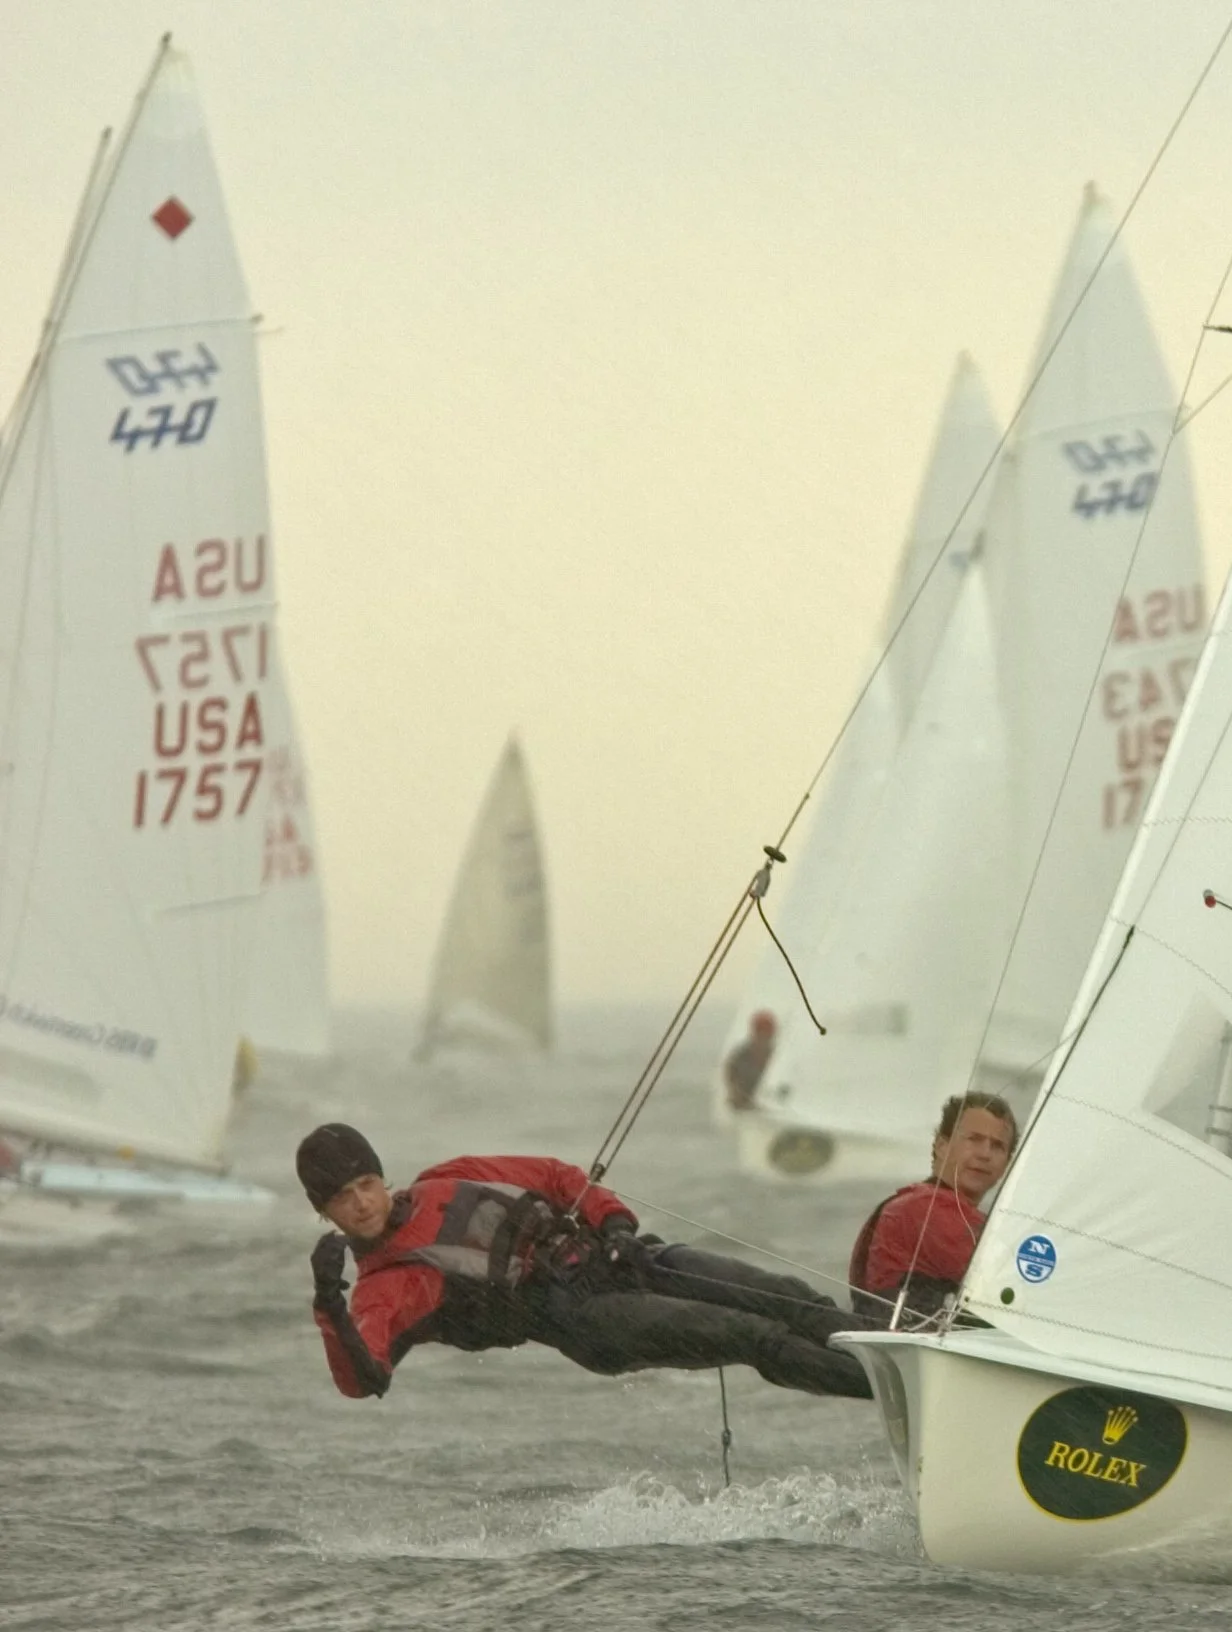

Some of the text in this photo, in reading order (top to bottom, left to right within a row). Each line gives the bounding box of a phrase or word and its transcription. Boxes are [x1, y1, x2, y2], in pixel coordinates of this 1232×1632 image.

[109, 397, 219, 453] 470
[1070, 471, 1160, 519] 470
[154, 692, 264, 758] USA
[1117, 716, 1177, 774] US
[133, 759, 263, 829] 1757
[1102, 778, 1145, 830] 17
[1044, 1441, 1147, 1487] ROLEX
